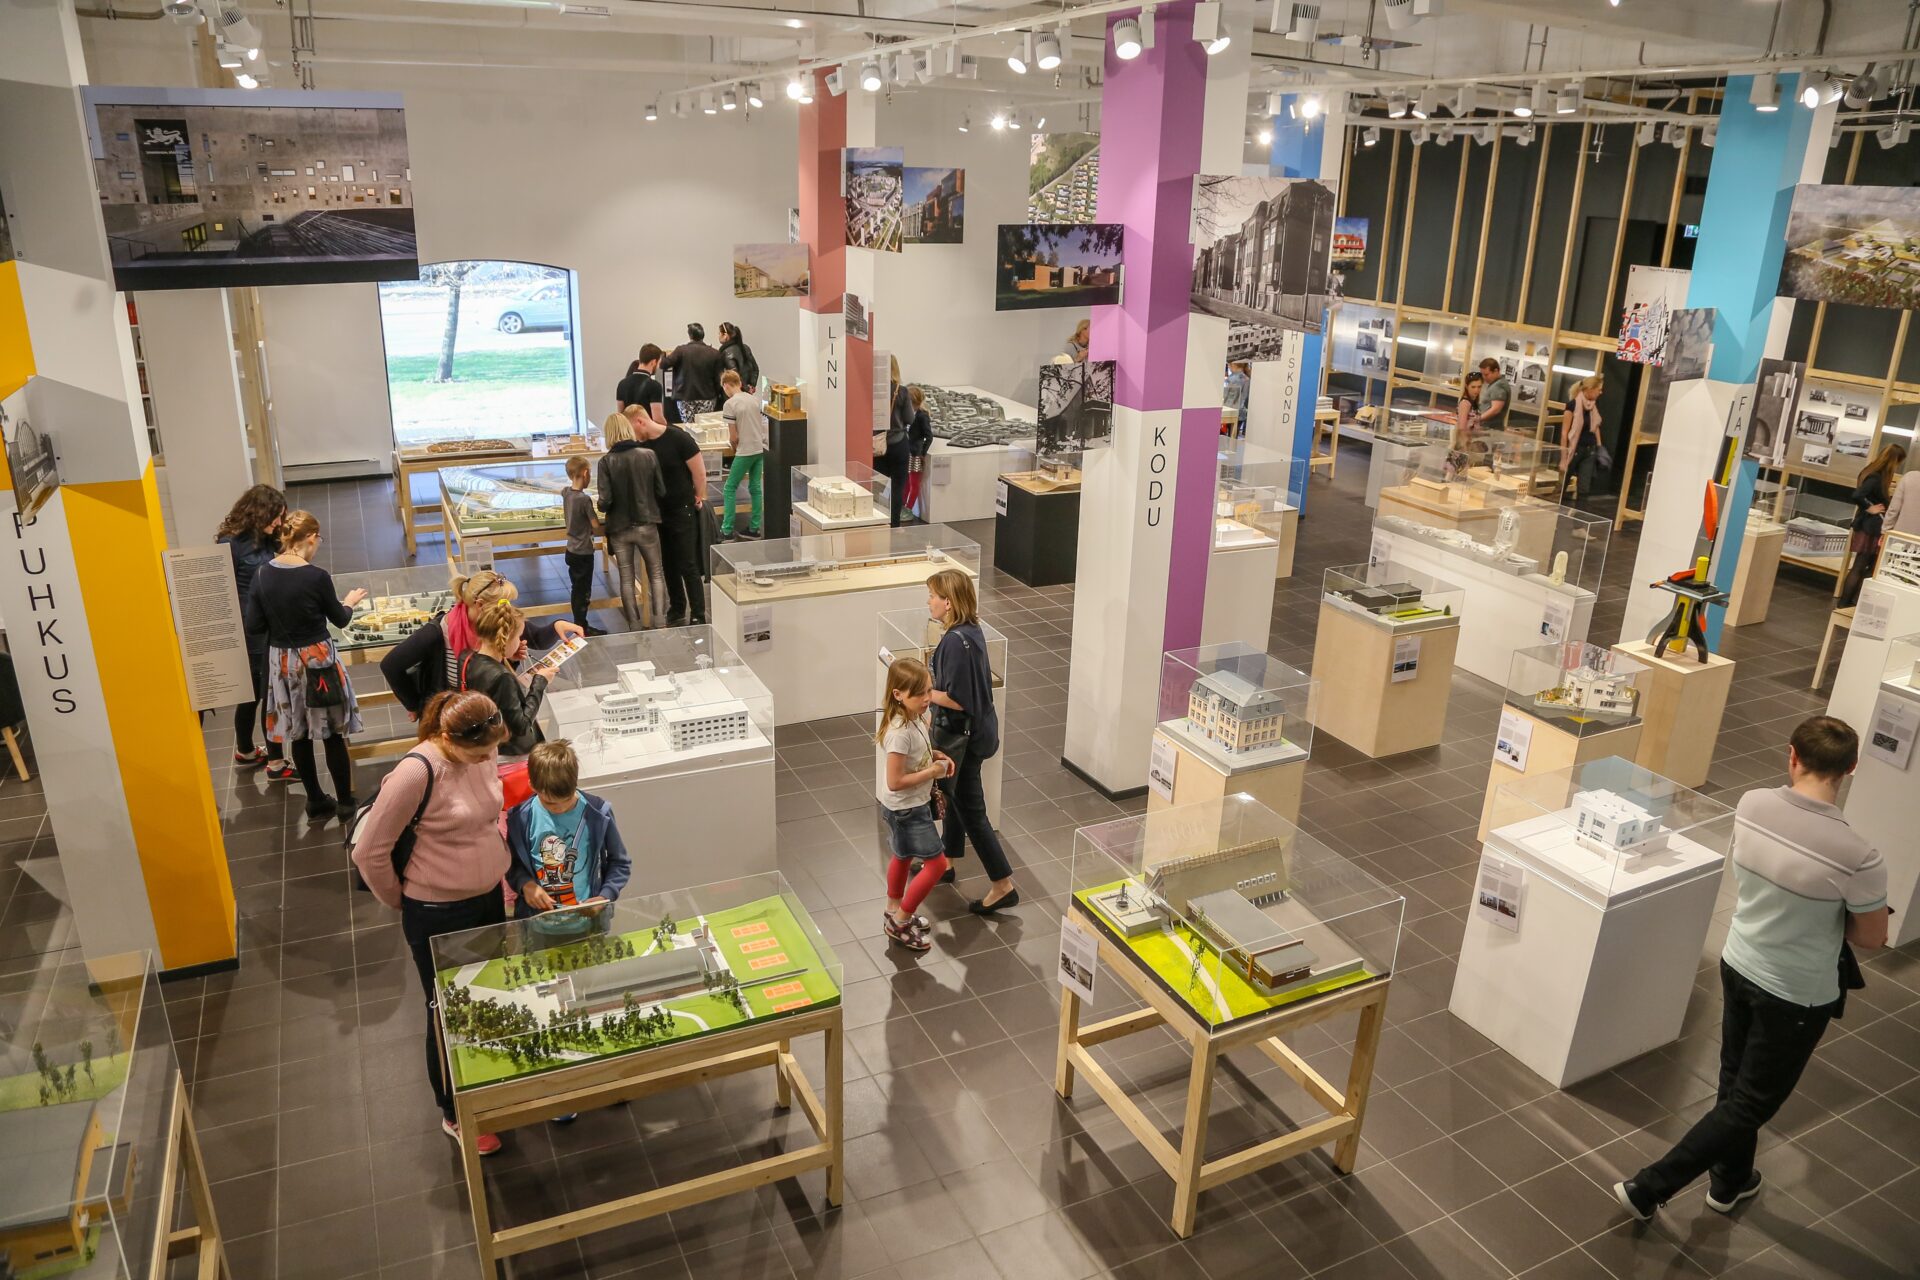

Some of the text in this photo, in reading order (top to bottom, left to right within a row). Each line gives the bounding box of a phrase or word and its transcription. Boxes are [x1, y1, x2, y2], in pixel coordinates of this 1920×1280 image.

[827, 325, 838, 390] LINN
[1146, 426, 1167, 527] KODU
[12, 511, 77, 714] PUHKUS
